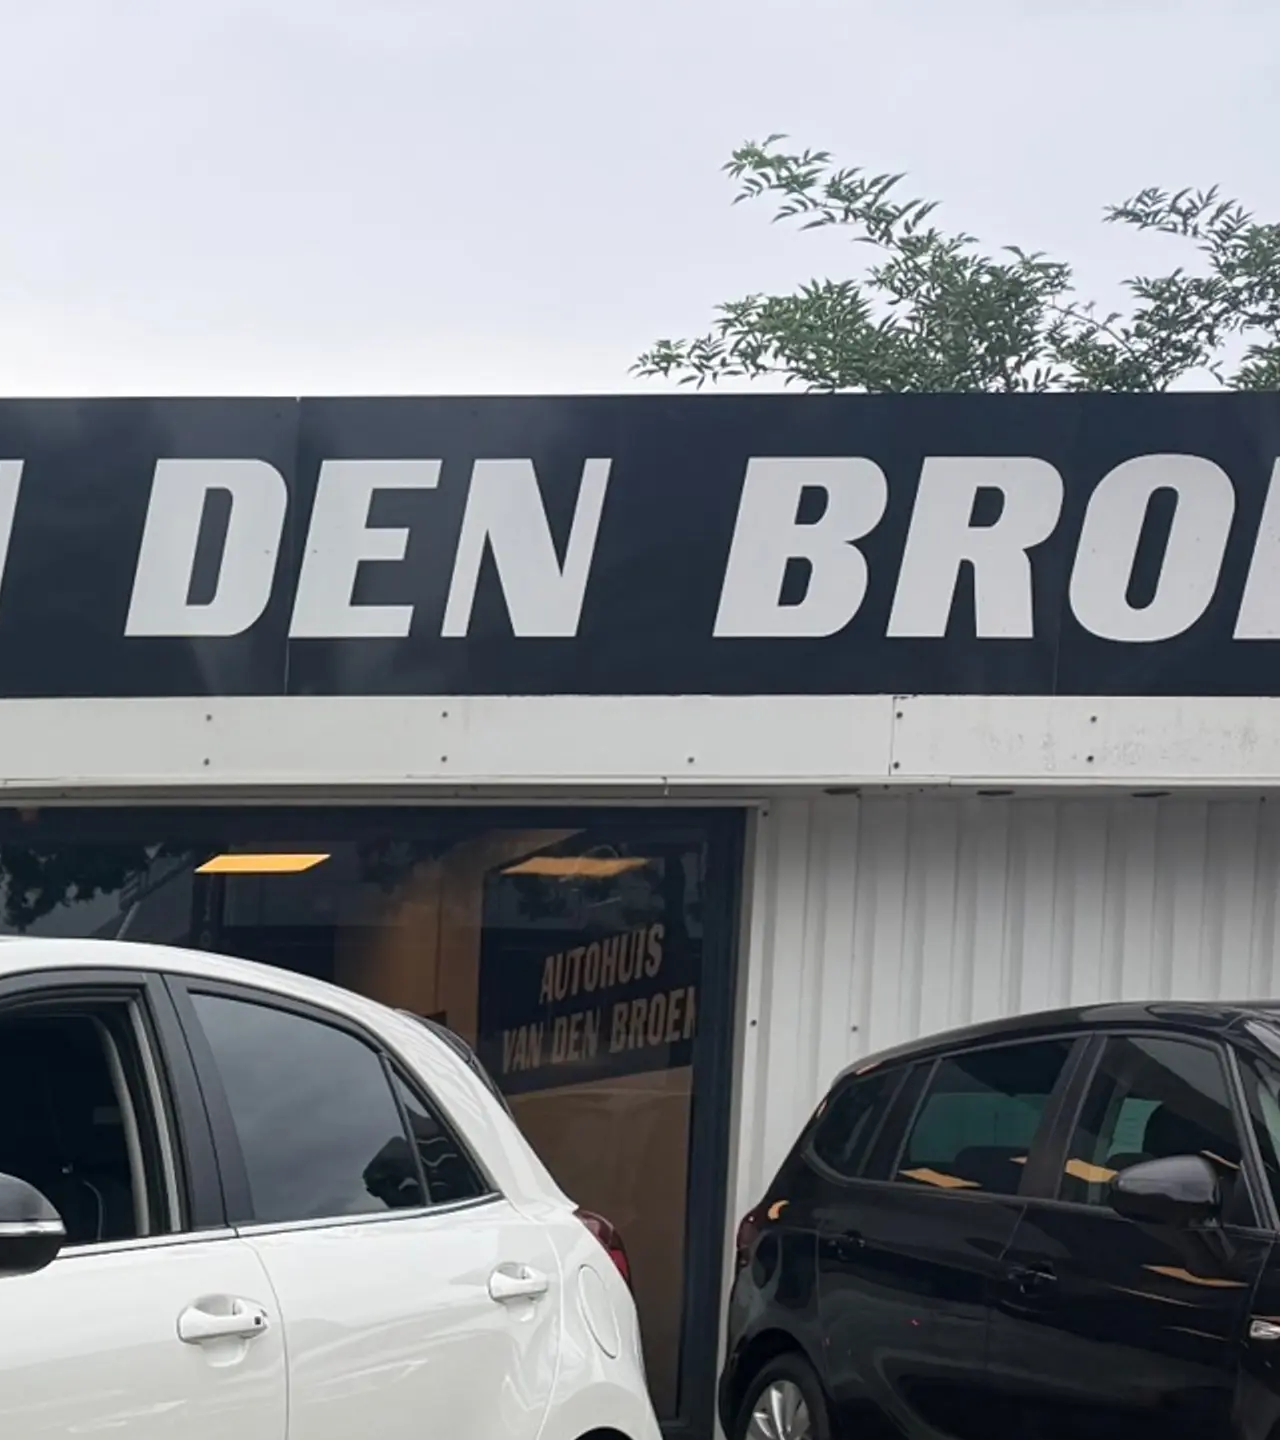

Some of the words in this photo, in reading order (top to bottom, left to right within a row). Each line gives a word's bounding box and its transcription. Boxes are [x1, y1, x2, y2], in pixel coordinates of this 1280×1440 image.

[124, 458, 613, 637] DEN
[539, 923, 664, 1005] AUTOHUIS
[503, 1022, 544, 1074] VAN
[552, 1006, 600, 1064] DEN
